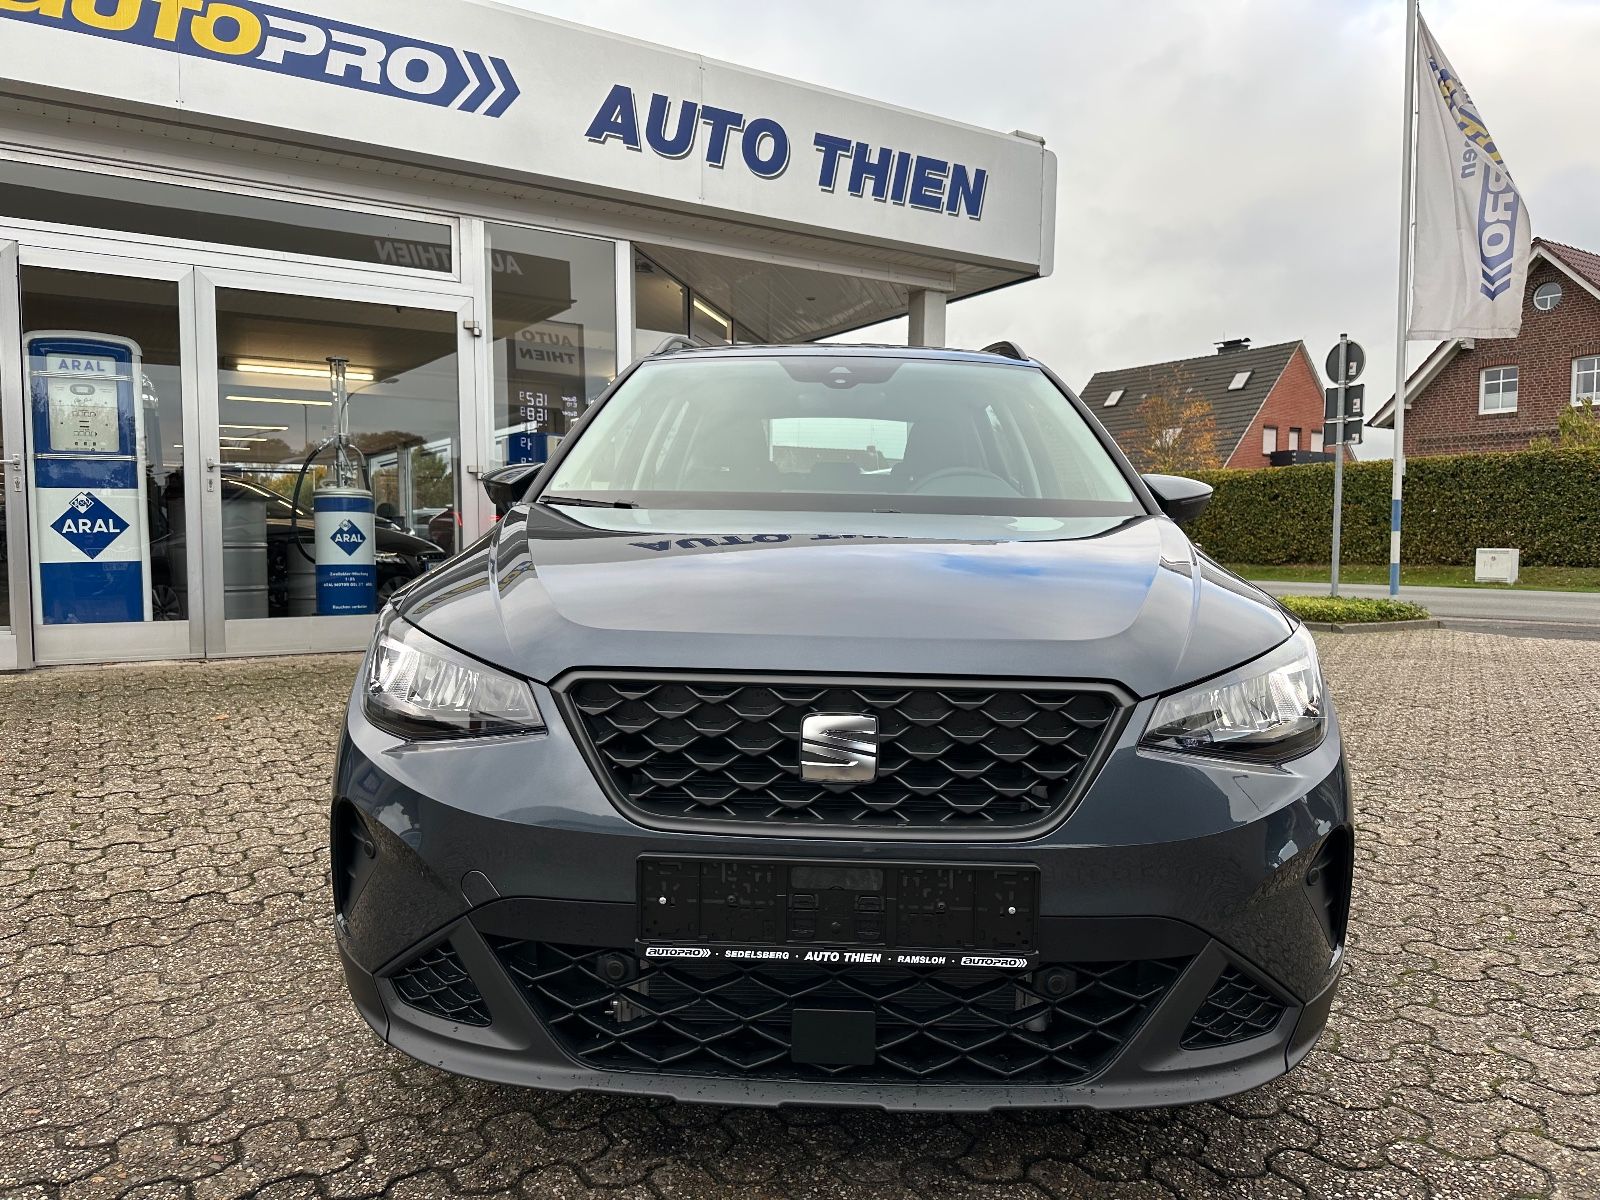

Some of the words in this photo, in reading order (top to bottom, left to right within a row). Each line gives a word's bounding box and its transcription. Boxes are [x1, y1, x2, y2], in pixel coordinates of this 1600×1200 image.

[0, 0, 448, 95] UTOPRO
[584, 84, 791, 178] AUTO
[813, 132, 989, 220] THIEN
[58, 358, 106, 373] ARAL
[61, 518, 121, 534] ARAL
[334, 533, 363, 543] ARAL
[725, 949, 790, 959] SEDELSBERG
[804, 951, 840, 962] AUTO
[843, 952, 882, 963] THIEN
[897, 955, 946, 965] RAMSLOH
